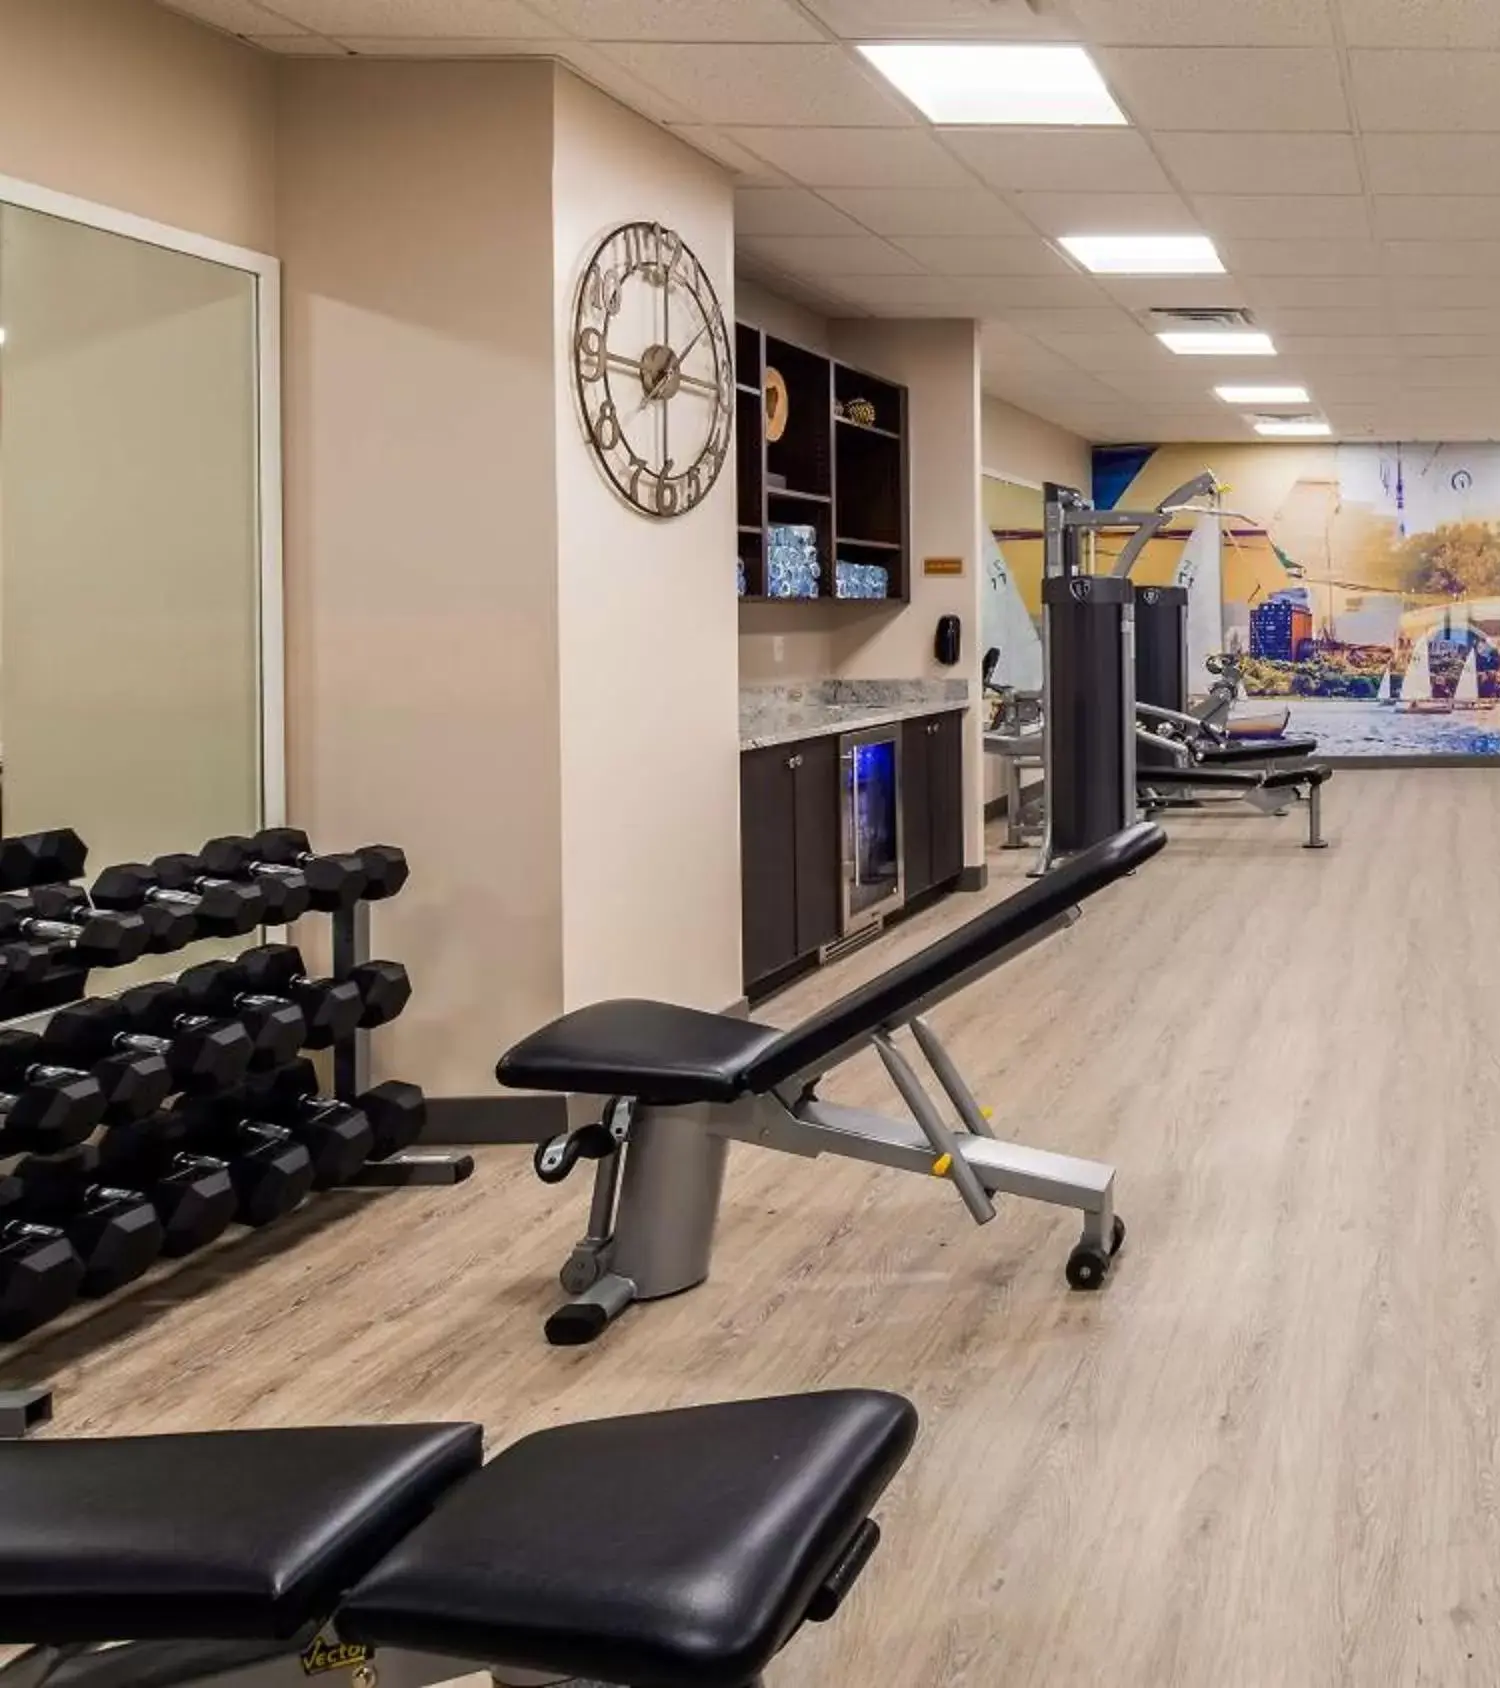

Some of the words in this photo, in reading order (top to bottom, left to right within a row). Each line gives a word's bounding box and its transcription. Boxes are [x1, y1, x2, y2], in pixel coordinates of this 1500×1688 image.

[580, 327, 606, 382] 9
[594, 400, 620, 450] 8
[627, 454, 648, 504] 7
[656, 458, 677, 516] 6
[687, 466, 701, 508] 5
